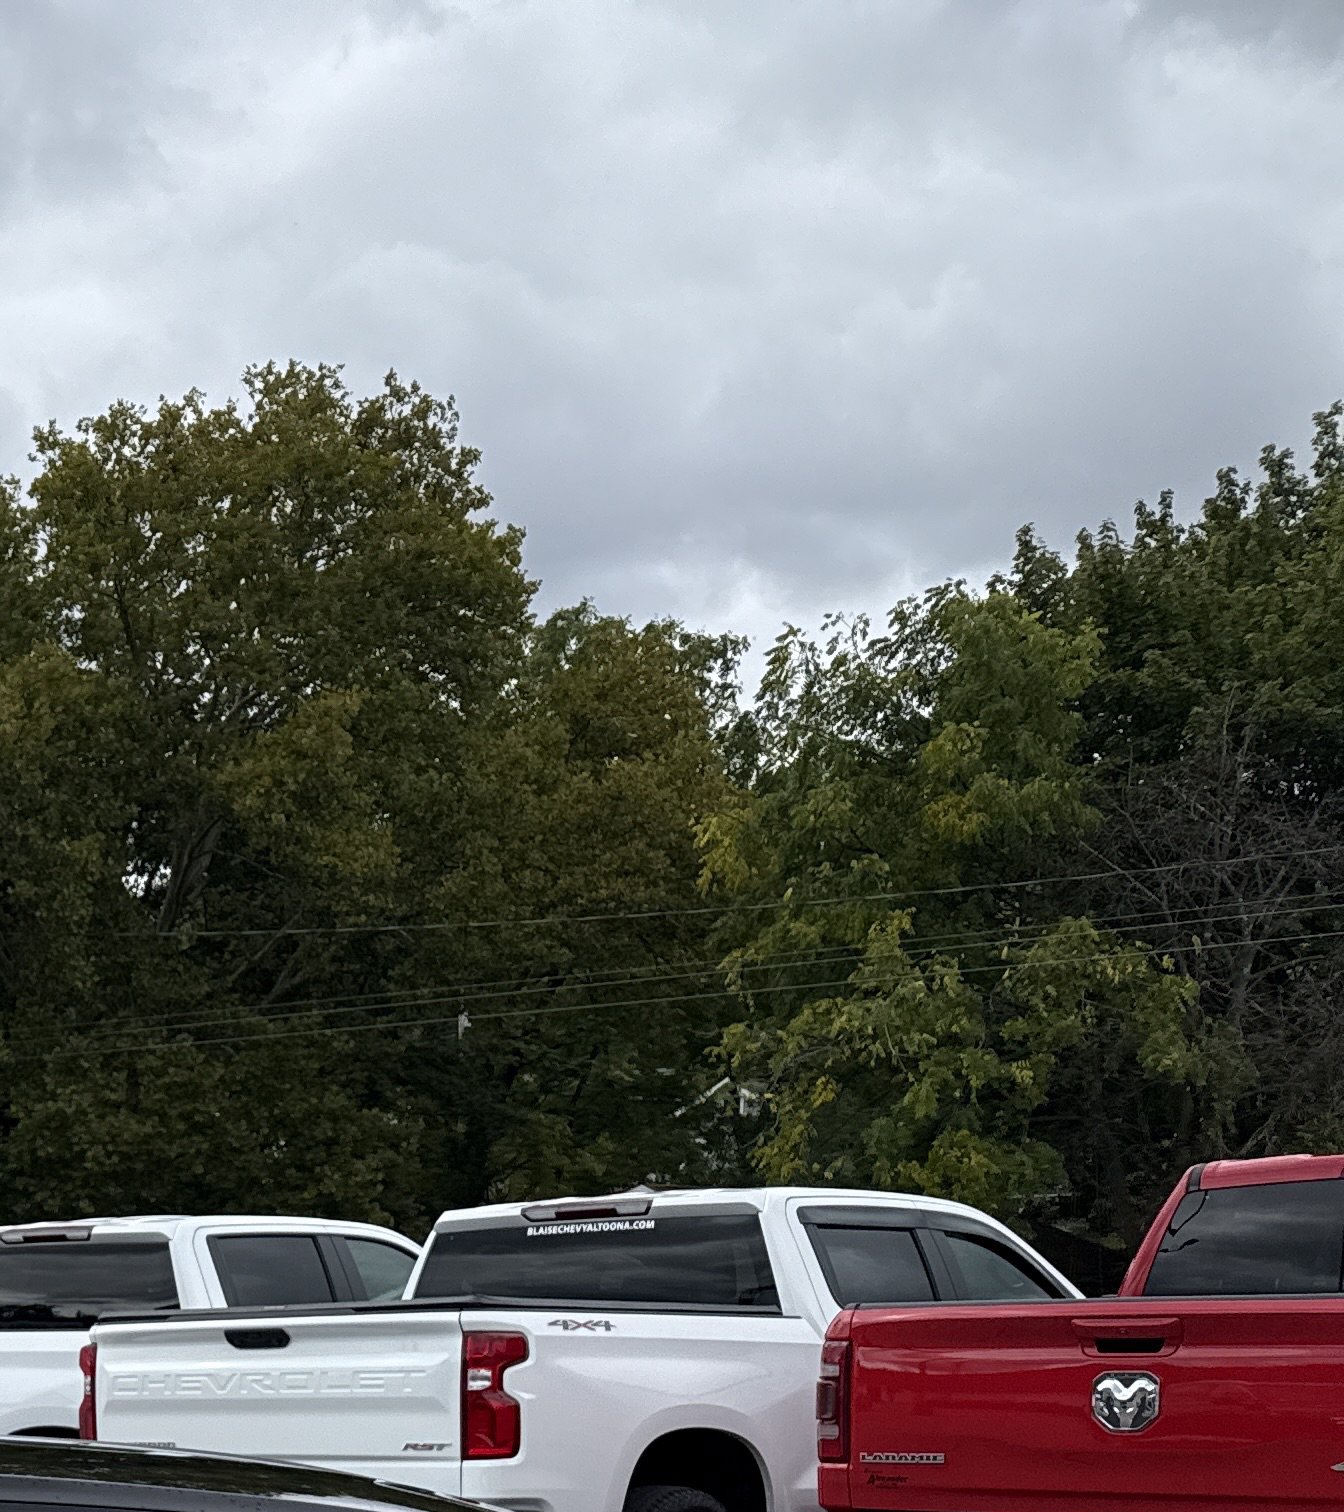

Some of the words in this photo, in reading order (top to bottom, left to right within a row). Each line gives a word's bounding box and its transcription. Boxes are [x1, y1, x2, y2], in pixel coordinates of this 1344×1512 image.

[527, 1220, 655, 1236] BLAISECHEVYALTOONA.COM
[111, 1370, 428, 1396] CHEVROLET
[402, 1442, 453, 1452] RST
[860, 1452, 945, 1464] LARAMIE
